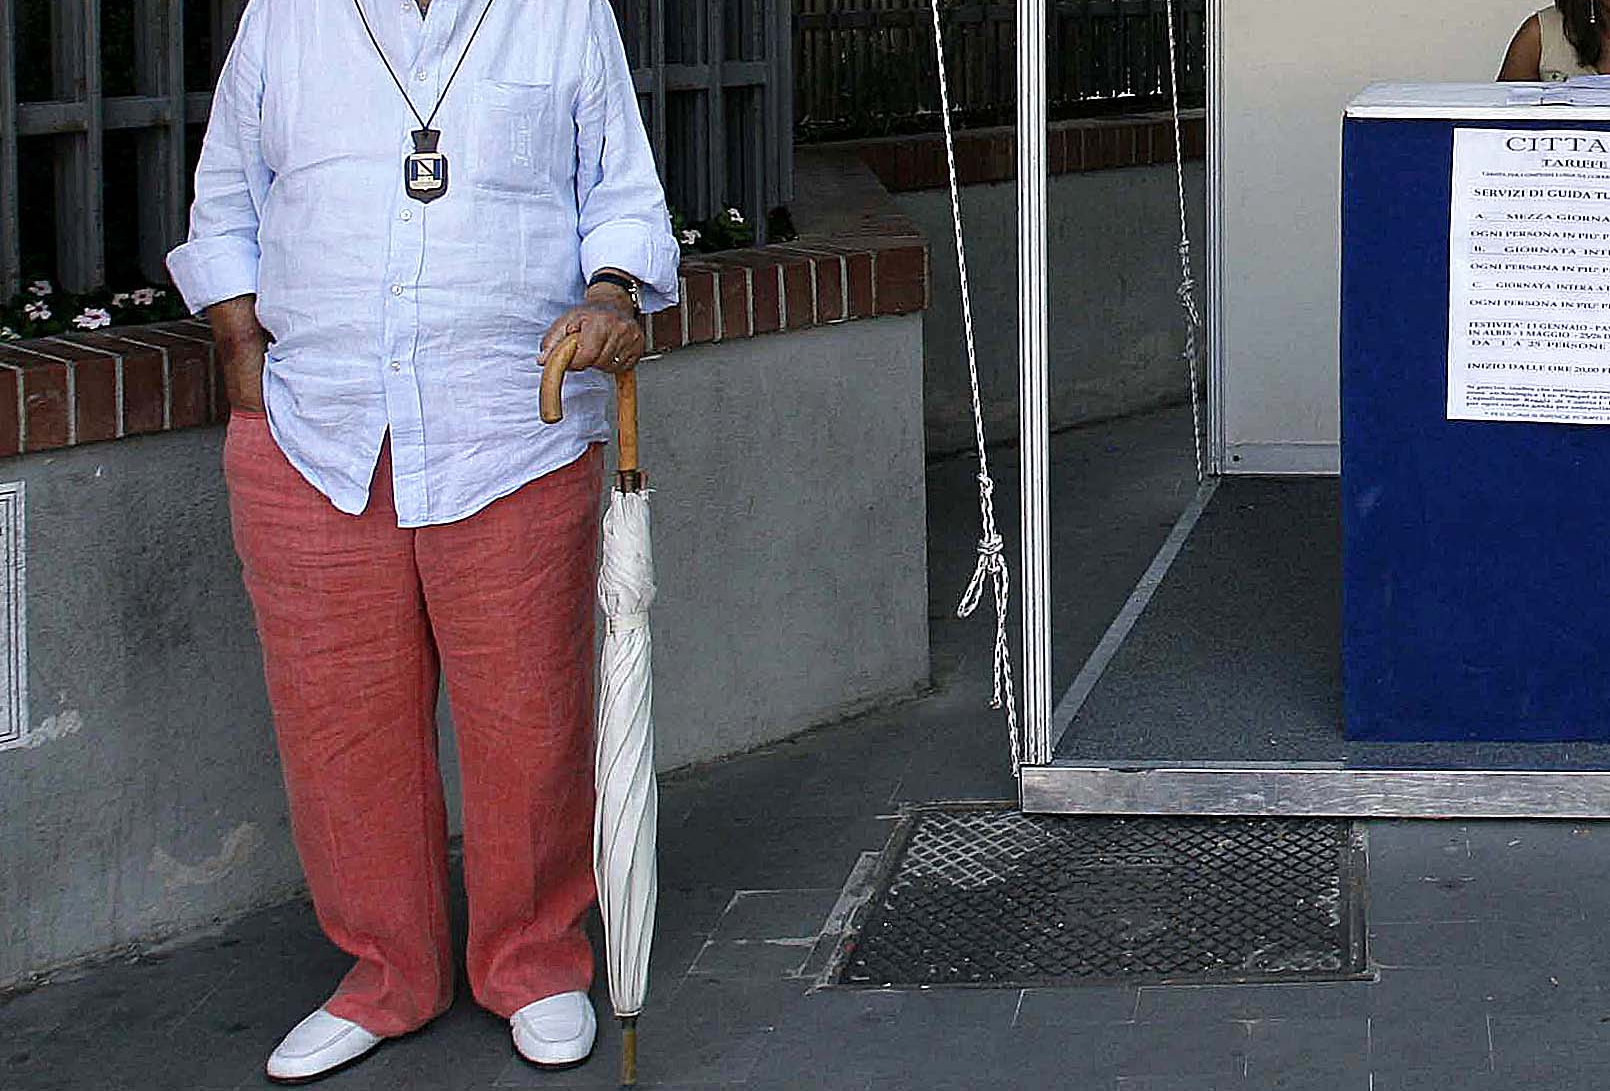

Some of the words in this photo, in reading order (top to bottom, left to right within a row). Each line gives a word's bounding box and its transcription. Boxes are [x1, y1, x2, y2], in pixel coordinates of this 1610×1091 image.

[1541, 159, 1609, 169] TARIFFE
[1473, 188, 1526, 197] SERVIZI
[1528, 189, 1544, 198] DI
[1547, 189, 1591, 200] GUIDA
[1506, 213, 1552, 221] MEZZA
[1471, 229, 1503, 238] OGNI
[1505, 230, 1560, 238] PERSONA
[1504, 245, 1577, 255] GIORNATA
[1469, 262, 1502, 271] OGNI
[1504, 263, 1559, 272] PERSONA
[1556, 283, 1594, 291] INTERA
[1469, 298, 1502, 307] OGNI
[1504, 299, 1558, 308] PERSONA
[1539, 322, 1589, 332] GENNAIO
[1468, 329, 1480, 337] IN
[1481, 329, 1512, 337] ALBIS
[1525, 331, 1571, 339] MAGGIO
[1547, 341, 1606, 350] PERSONE
[1467, 362, 1507, 371] INIZIO
[1508, 363, 1546, 372] DALLE
[1548, 364, 1570, 373] ORE
